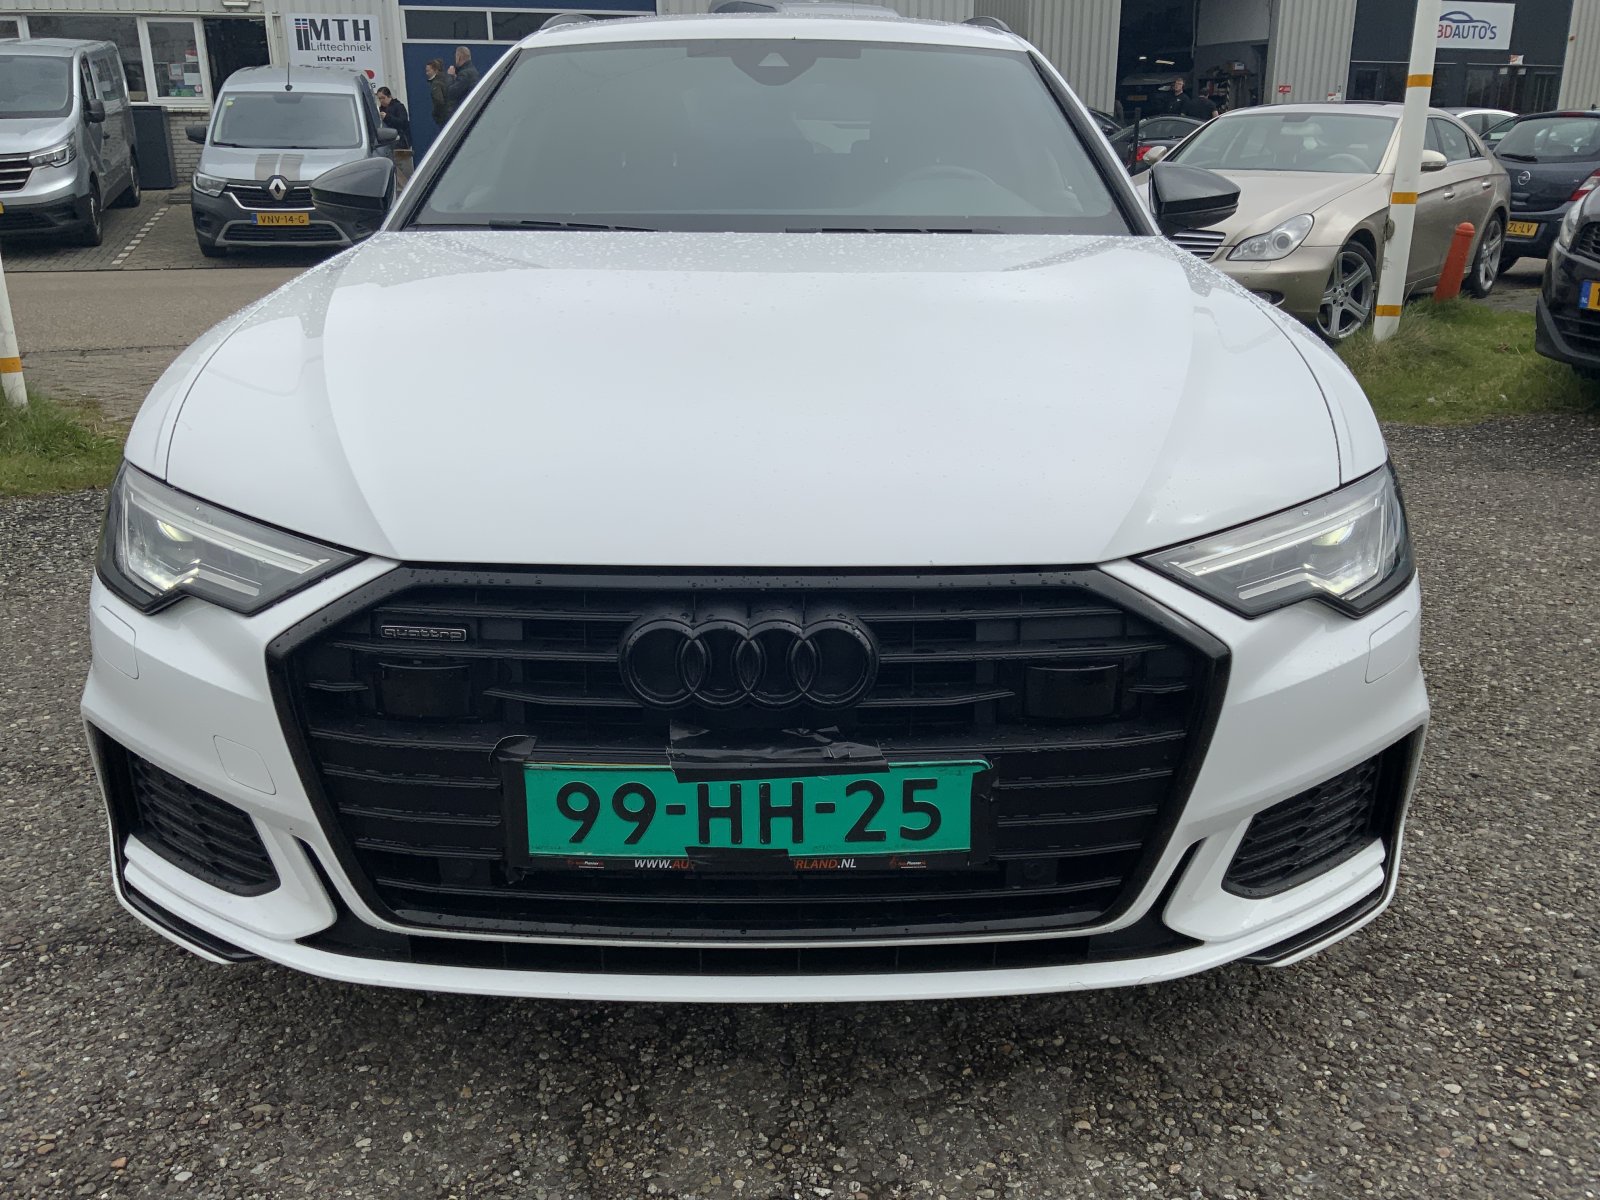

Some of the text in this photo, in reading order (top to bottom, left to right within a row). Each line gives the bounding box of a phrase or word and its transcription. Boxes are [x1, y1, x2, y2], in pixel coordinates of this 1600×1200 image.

[308, 18, 372, 42] MTH
[310, 42, 373, 52] Lifttechniek
[260, 215, 305, 224] VNV-14-G
[384, 628, 462, 639] quattro
[556, 778, 942, 845] 99-HH-25
[634, 858, 857, 869] WWW.AU RLAND.NL
